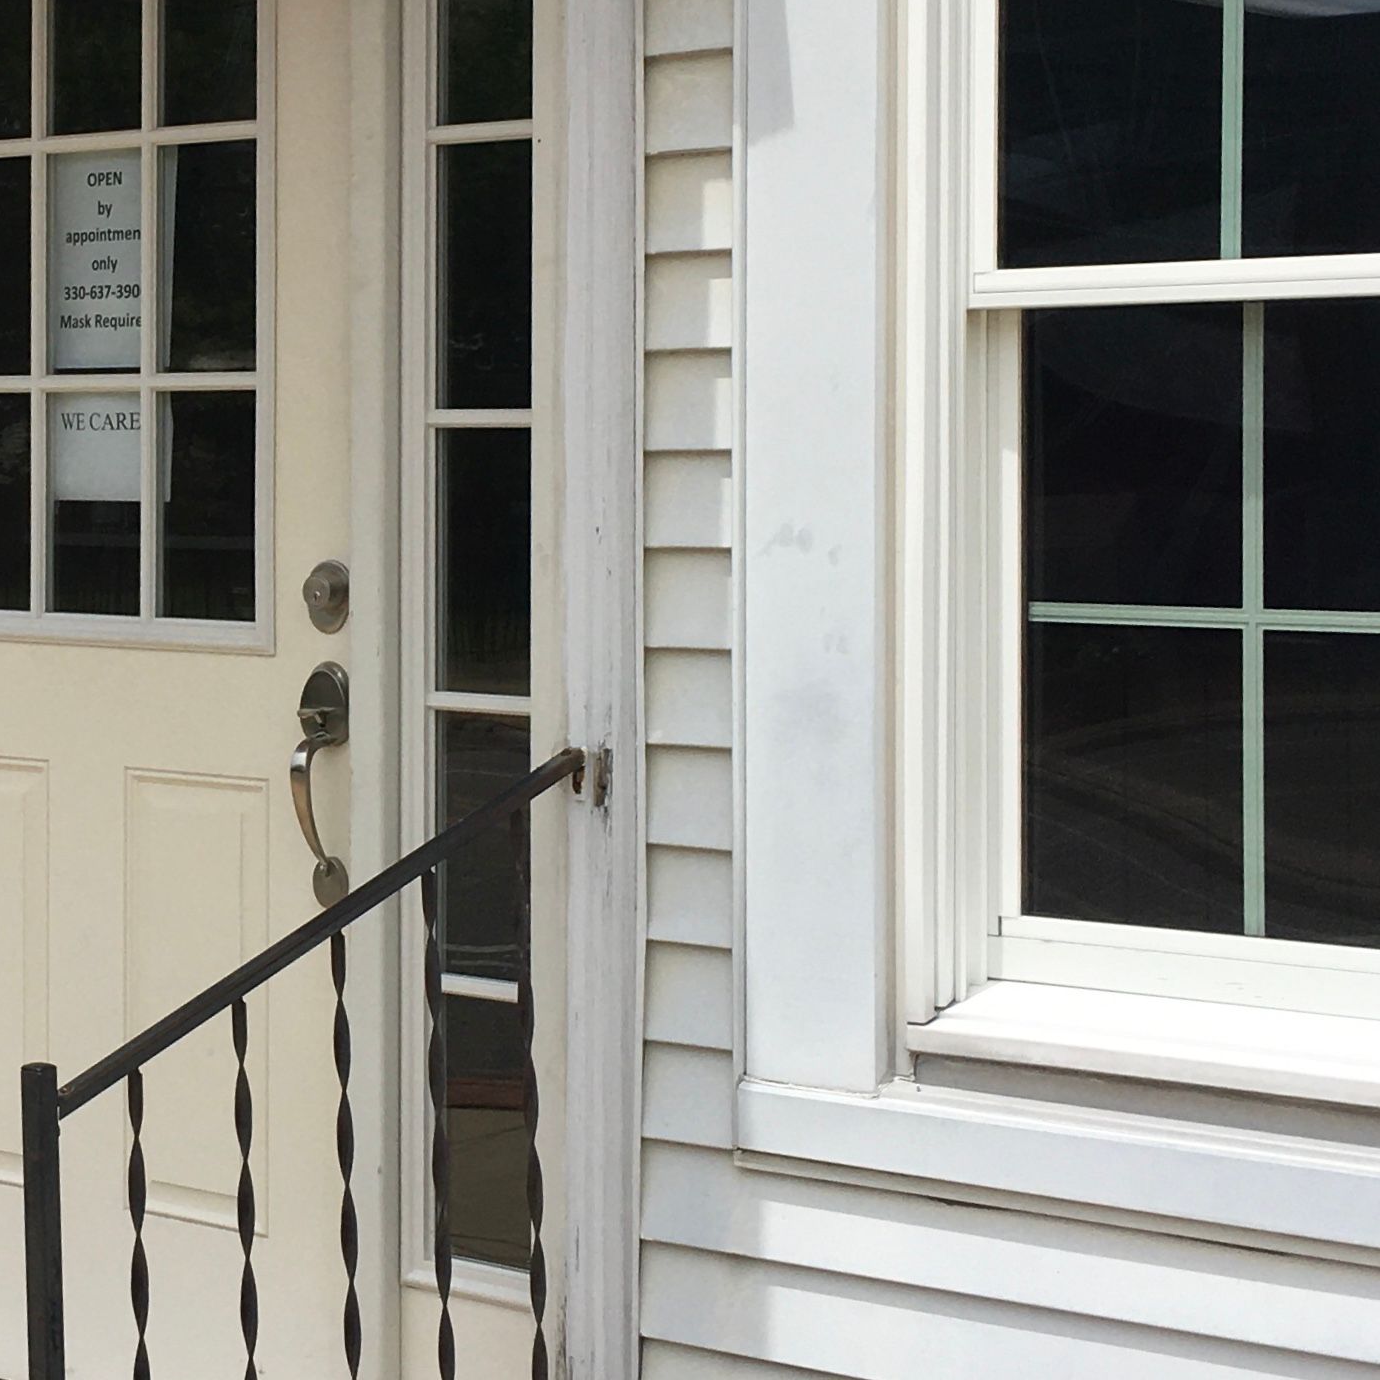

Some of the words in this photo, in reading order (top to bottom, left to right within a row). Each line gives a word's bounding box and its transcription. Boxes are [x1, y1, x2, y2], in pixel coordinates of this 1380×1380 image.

[87, 171, 122, 187] OPEN
[97, 201, 112, 218] by
[65, 228, 141, 246] appointmen
[91, 256, 117, 273] only
[64, 284, 141, 300] 330-637-390
[60, 314, 91, 329] Mask
[95, 313, 141, 331] Require
[61, 412, 85, 431] WE
[89, 412, 141, 431] CARE
